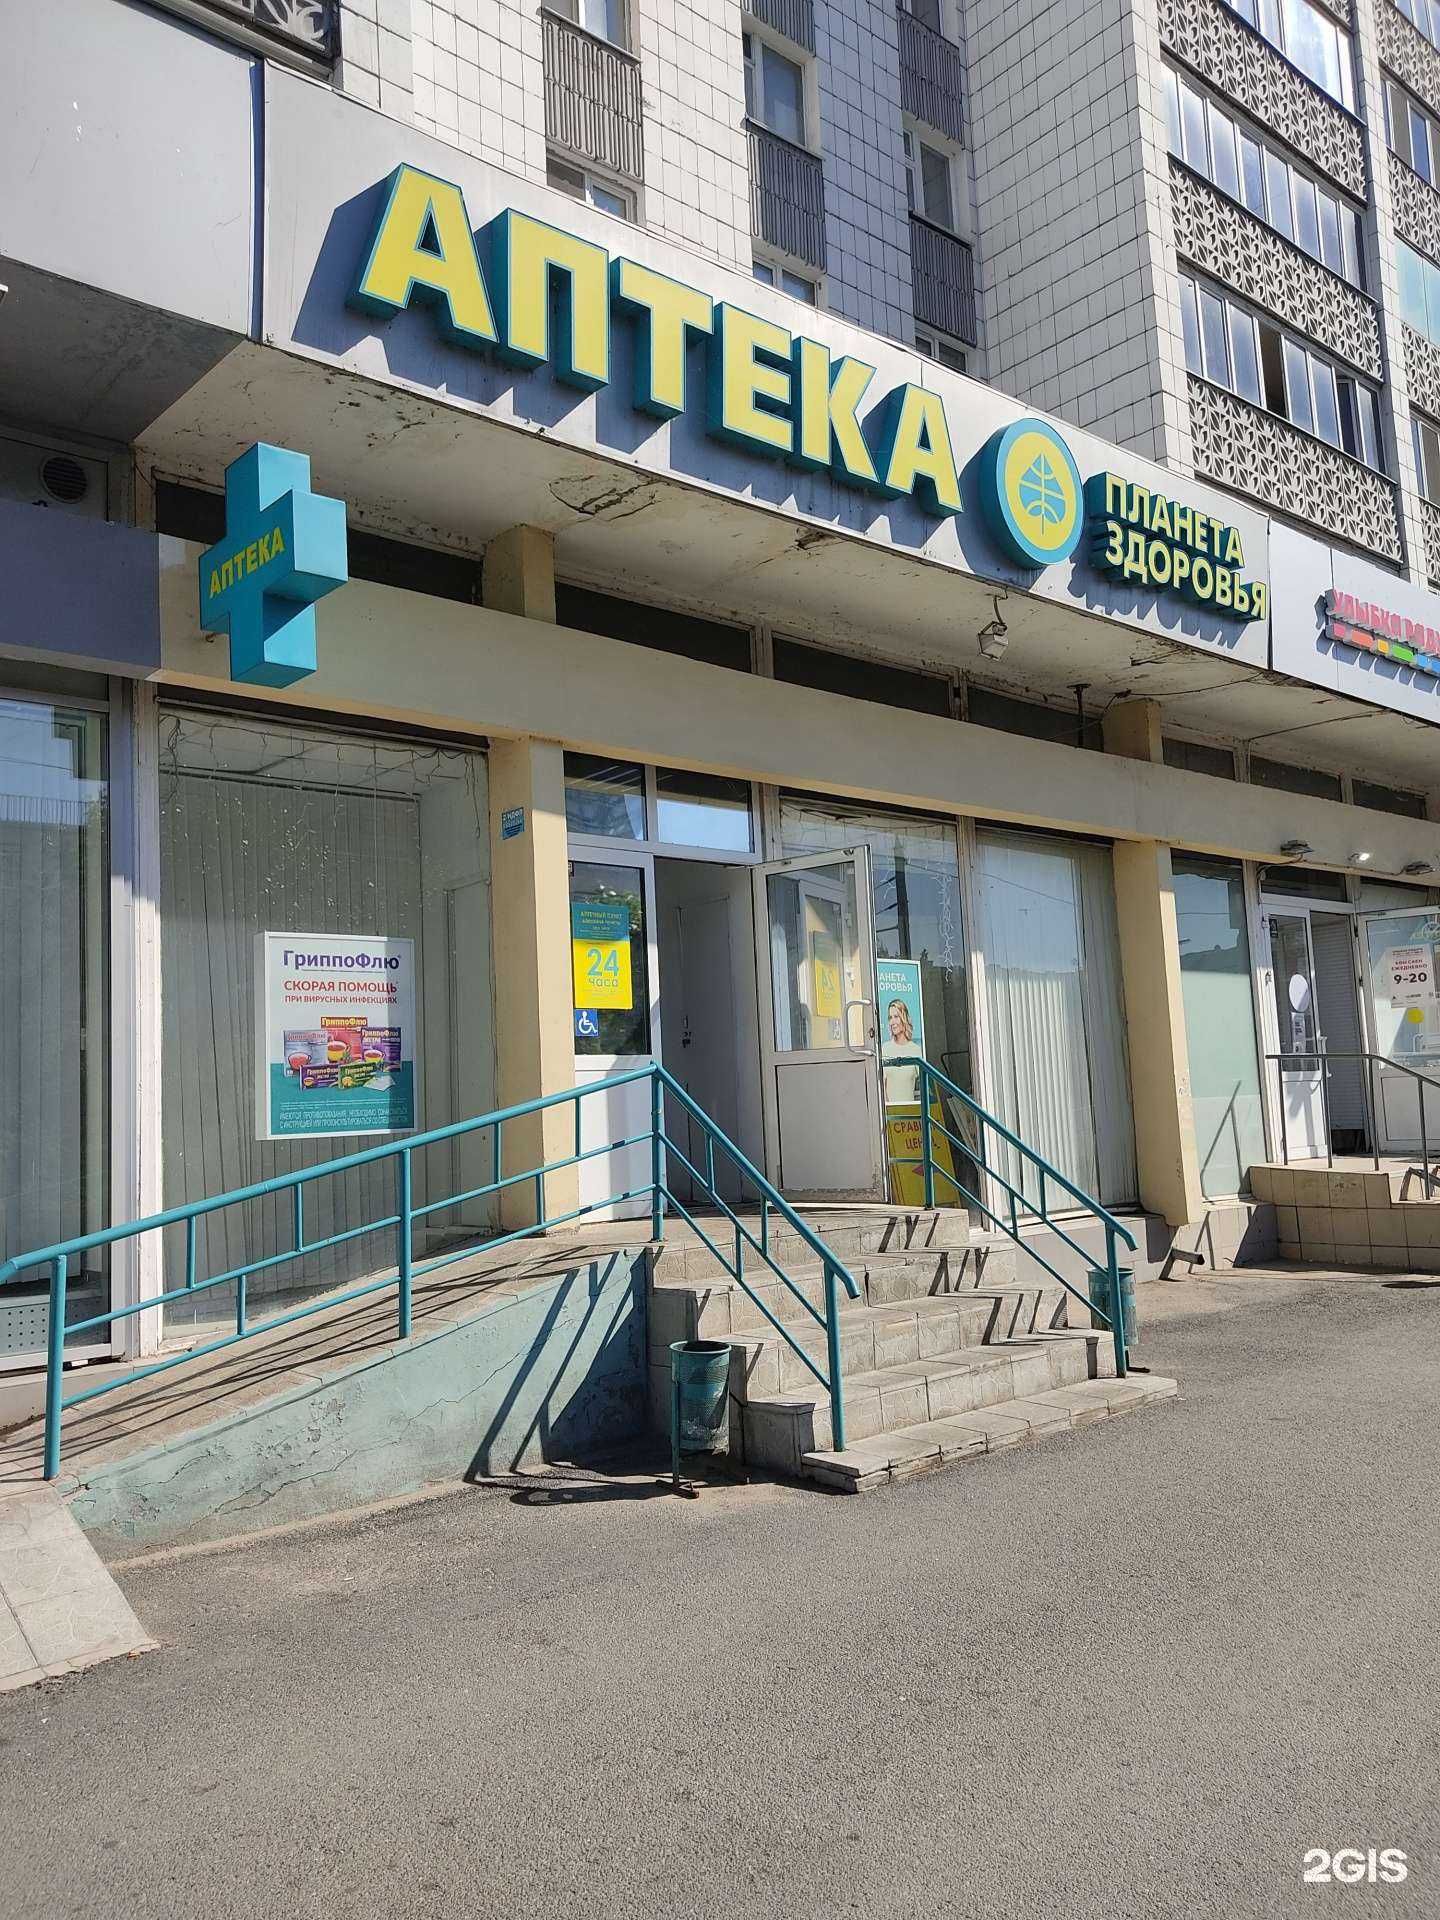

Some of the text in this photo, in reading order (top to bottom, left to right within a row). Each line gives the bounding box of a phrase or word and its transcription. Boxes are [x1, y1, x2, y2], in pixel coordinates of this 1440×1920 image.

[355, 162, 965, 516] АПТЕКА
[1105, 472, 1245, 568] ПЛАНЕТА
[209, 526, 285, 600] АПТЕКА
[1105, 519, 1267, 621] ЗДОРОВЬЯ
[1327, 589, 1401, 640] УЛЫБКА
[283, 950, 400, 970] ГриппоФлю
[587, 947, 619, 977] 24
[1393, 972, 1428, 985] 9-20
[283, 980, 398, 995] СКОРАЯ ПОМОЩЬ
[284, 995, 398, 1005] ПРИ ВИРУСНЫХ ИНФЕКЦИЯХ
